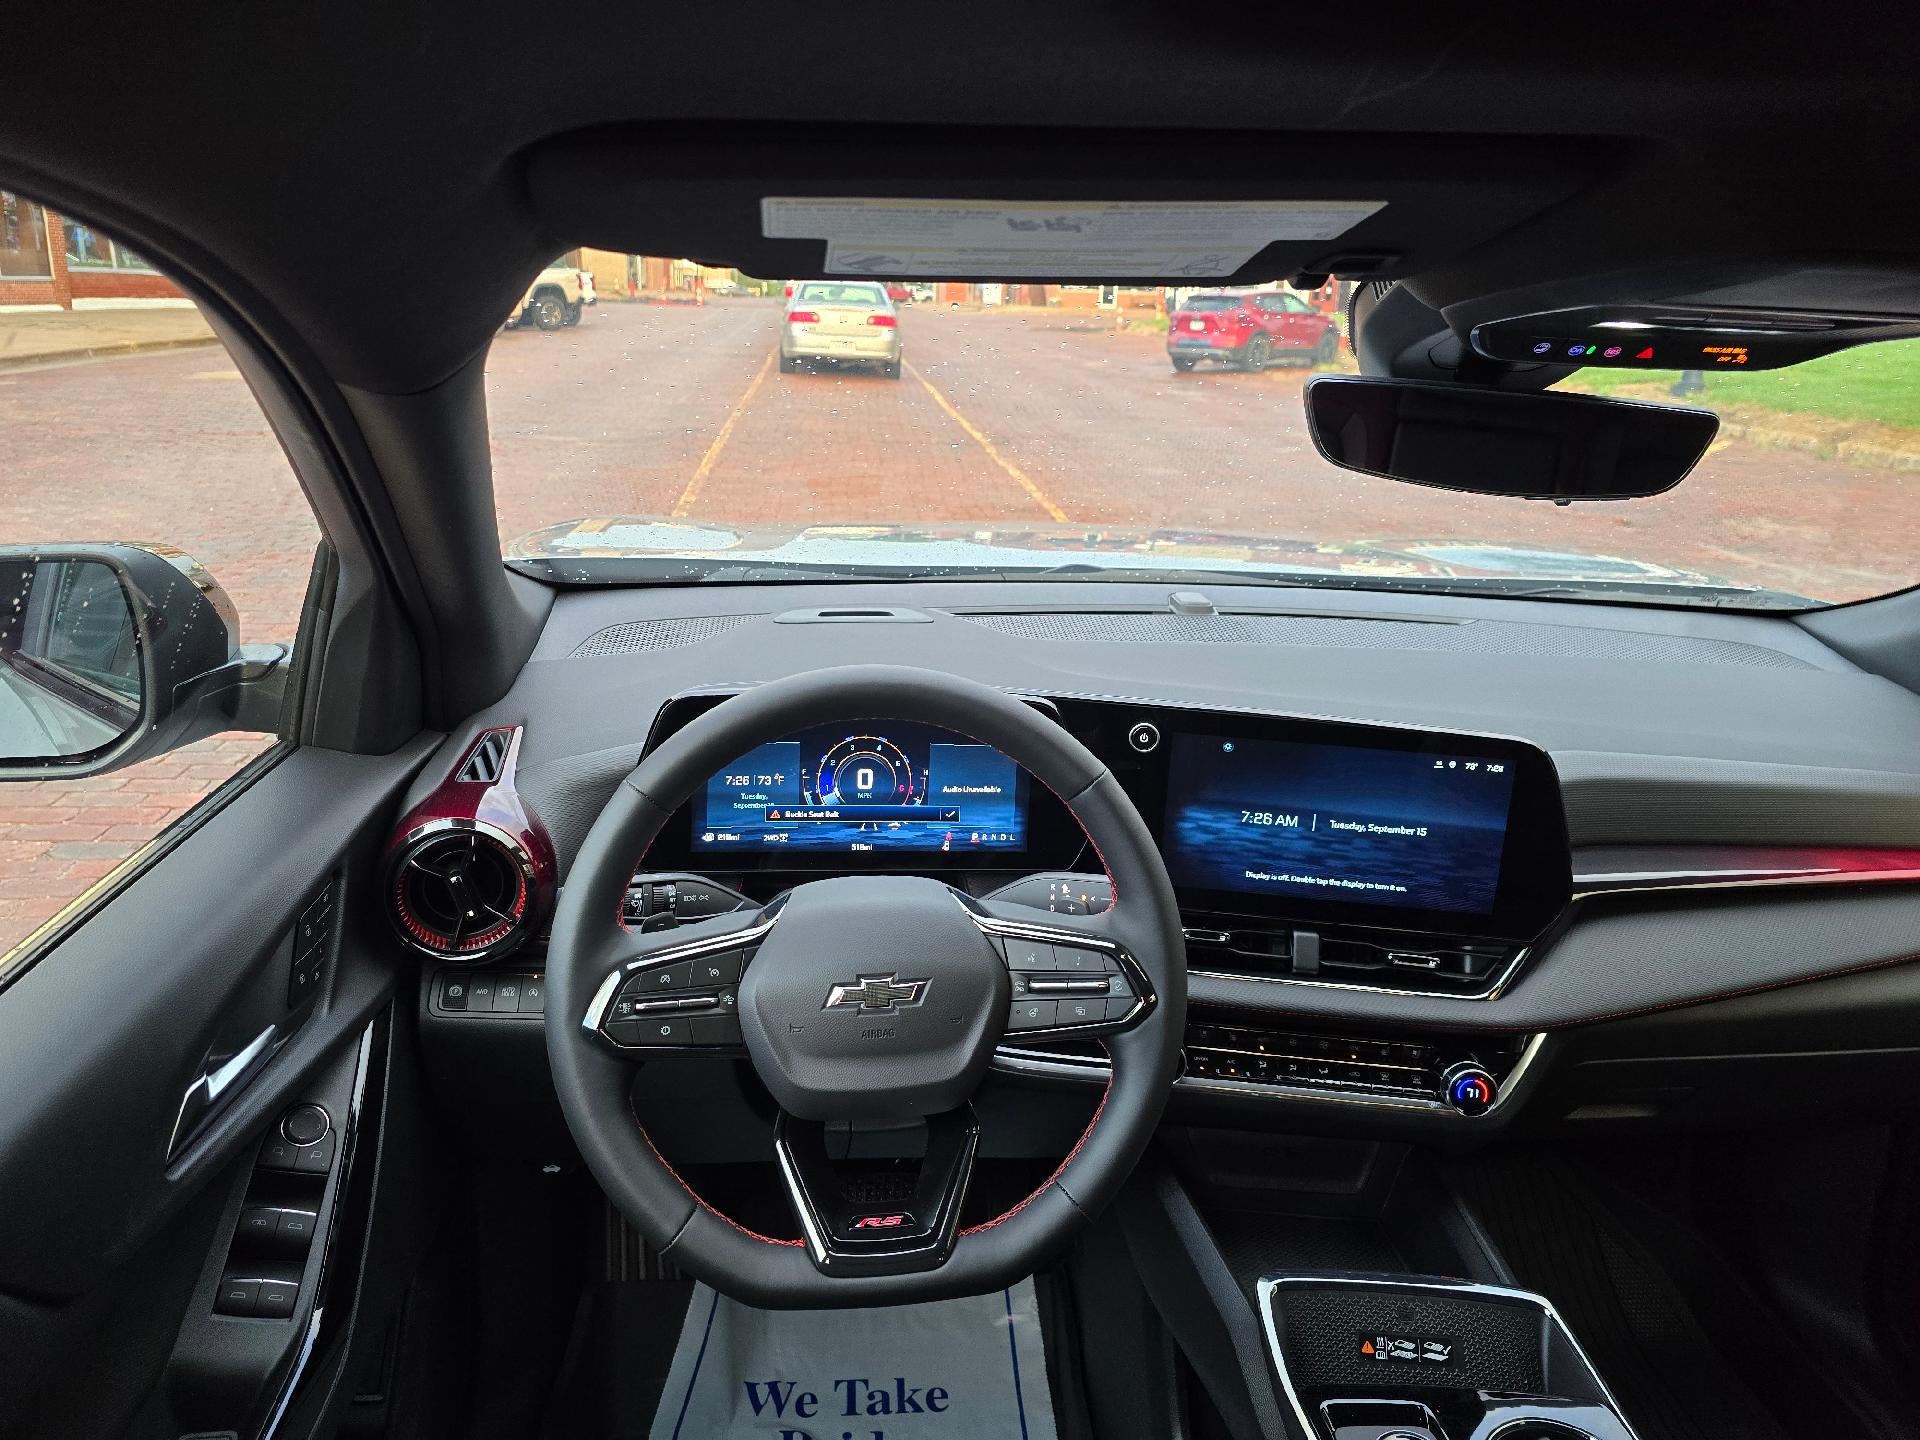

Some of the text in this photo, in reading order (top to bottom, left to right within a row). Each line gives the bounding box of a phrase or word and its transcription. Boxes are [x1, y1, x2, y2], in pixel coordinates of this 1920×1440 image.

[725, 775, 750, 786] 7:26
[757, 775, 772, 786] 73
[857, 768, 873, 790] 0
[942, 785, 1002, 793] Audio Unavailable
[785, 810, 840, 818] Buckle Seat Belt
[1241, 810, 1428, 837] 7:26 AM Tuesday, September 15
[1245, 870, 1271, 881] Display
[1290, 875, 1316, 884] Double
[1316, 878, 1328, 886] tap
[1329, 878, 1342, 886] the
[1341, 879, 1367, 889] display
[1375, 883, 1390, 891] turn
[861, 1029, 896, 1040] AIRBAG
[855, 1215, 904, 1228] RS
[744, 1377, 949, 1418] We Take
